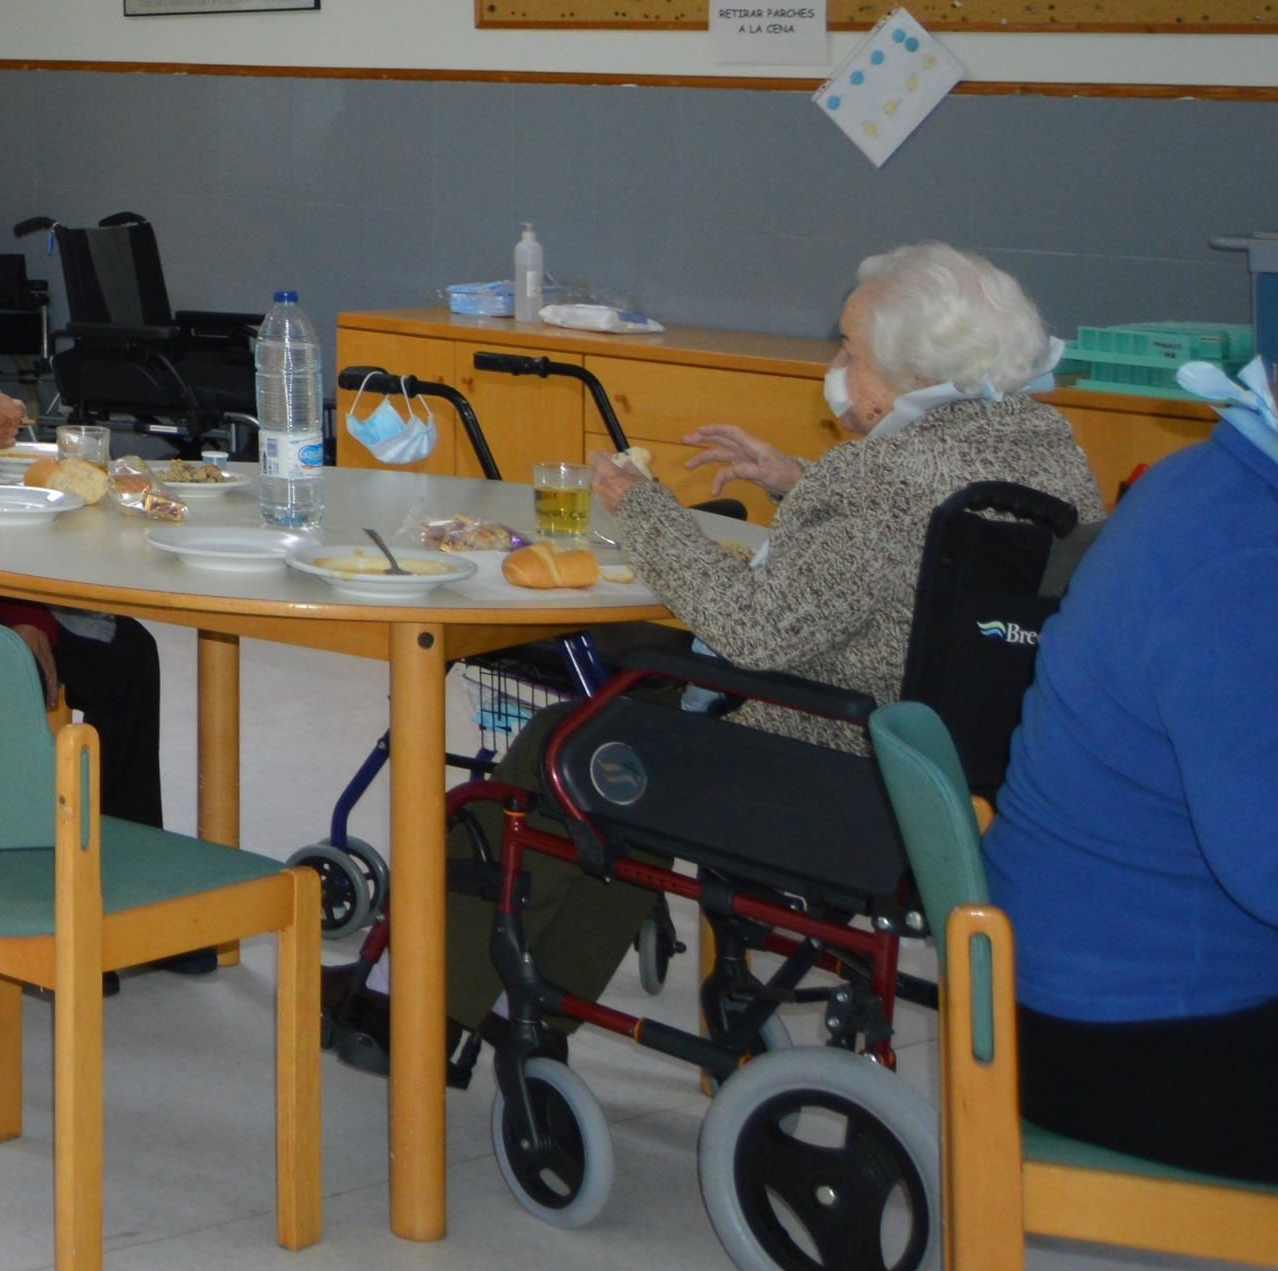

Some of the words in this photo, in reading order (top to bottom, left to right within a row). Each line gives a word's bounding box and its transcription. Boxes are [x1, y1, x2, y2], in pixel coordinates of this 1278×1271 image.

[718, 9, 764, 19] RETIRAR
[767, 8, 815, 18] PARCHES
[738, 25, 746, 33] A
[749, 24, 763, 34] LA
[766, 23, 795, 34] CENA
